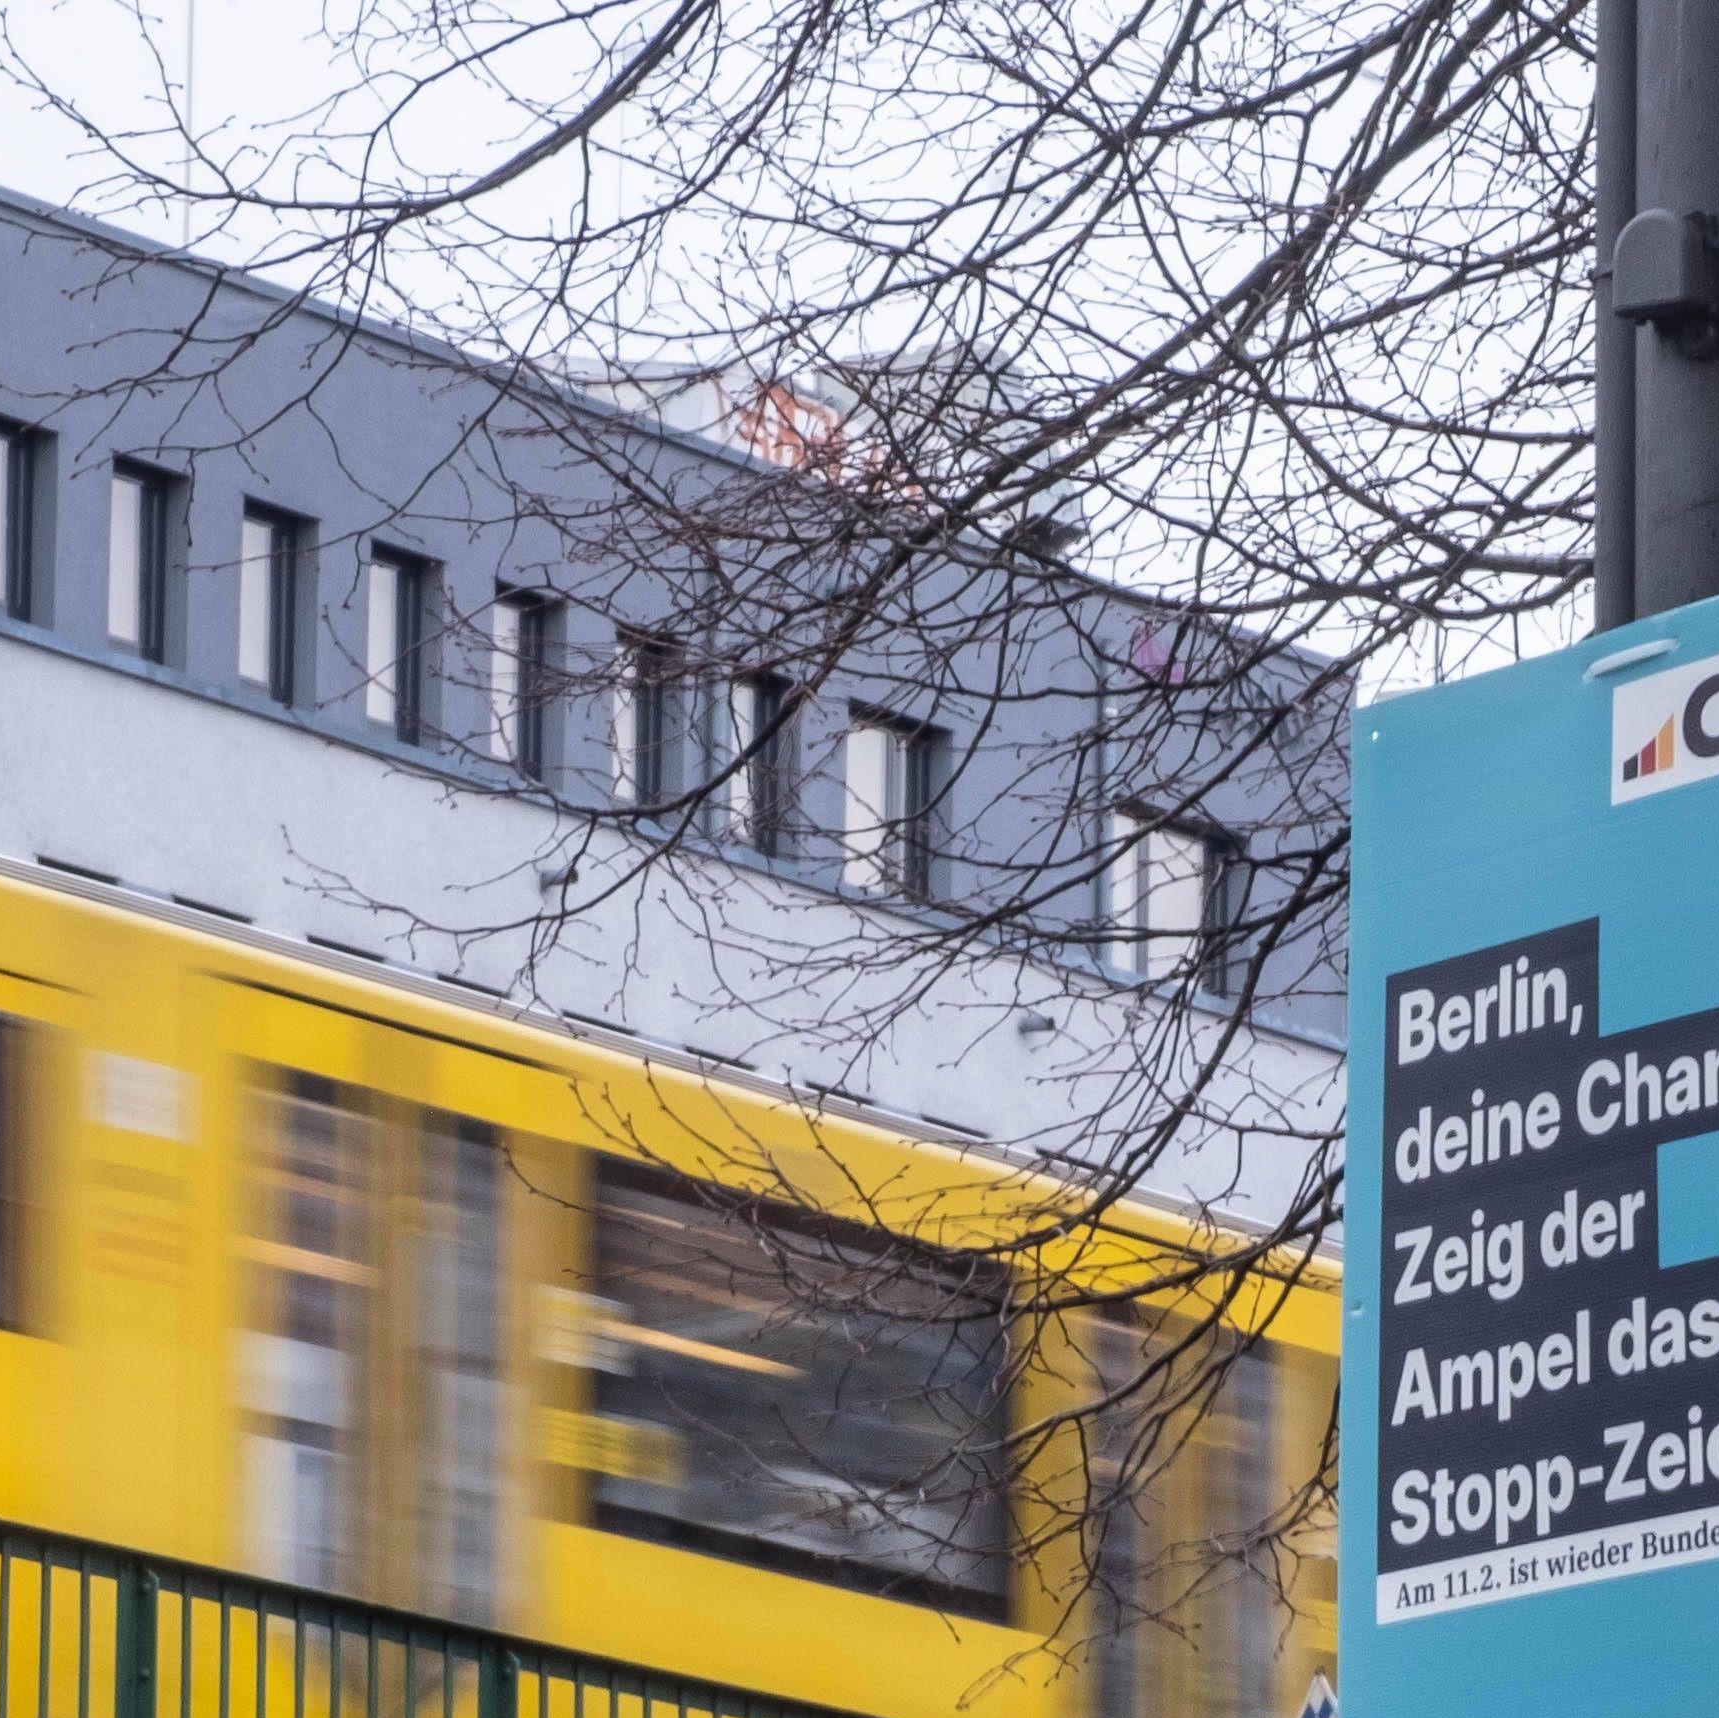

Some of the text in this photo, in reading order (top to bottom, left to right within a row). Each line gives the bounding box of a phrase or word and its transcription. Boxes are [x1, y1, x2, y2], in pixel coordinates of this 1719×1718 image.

[1398, 956, 1583, 1066] Berlin,
[1395, 1087, 1561, 1184] deine
[1394, 1189, 1646, 1306] Zeig der
[1391, 1308, 1591, 1427] Ampel
[1395, 1582, 1436, 1610] Am
[1444, 1564, 1501, 1600] 11.2.
[1510, 1556, 1539, 1587] ist
[1547, 1538, 1633, 1578] wieder
